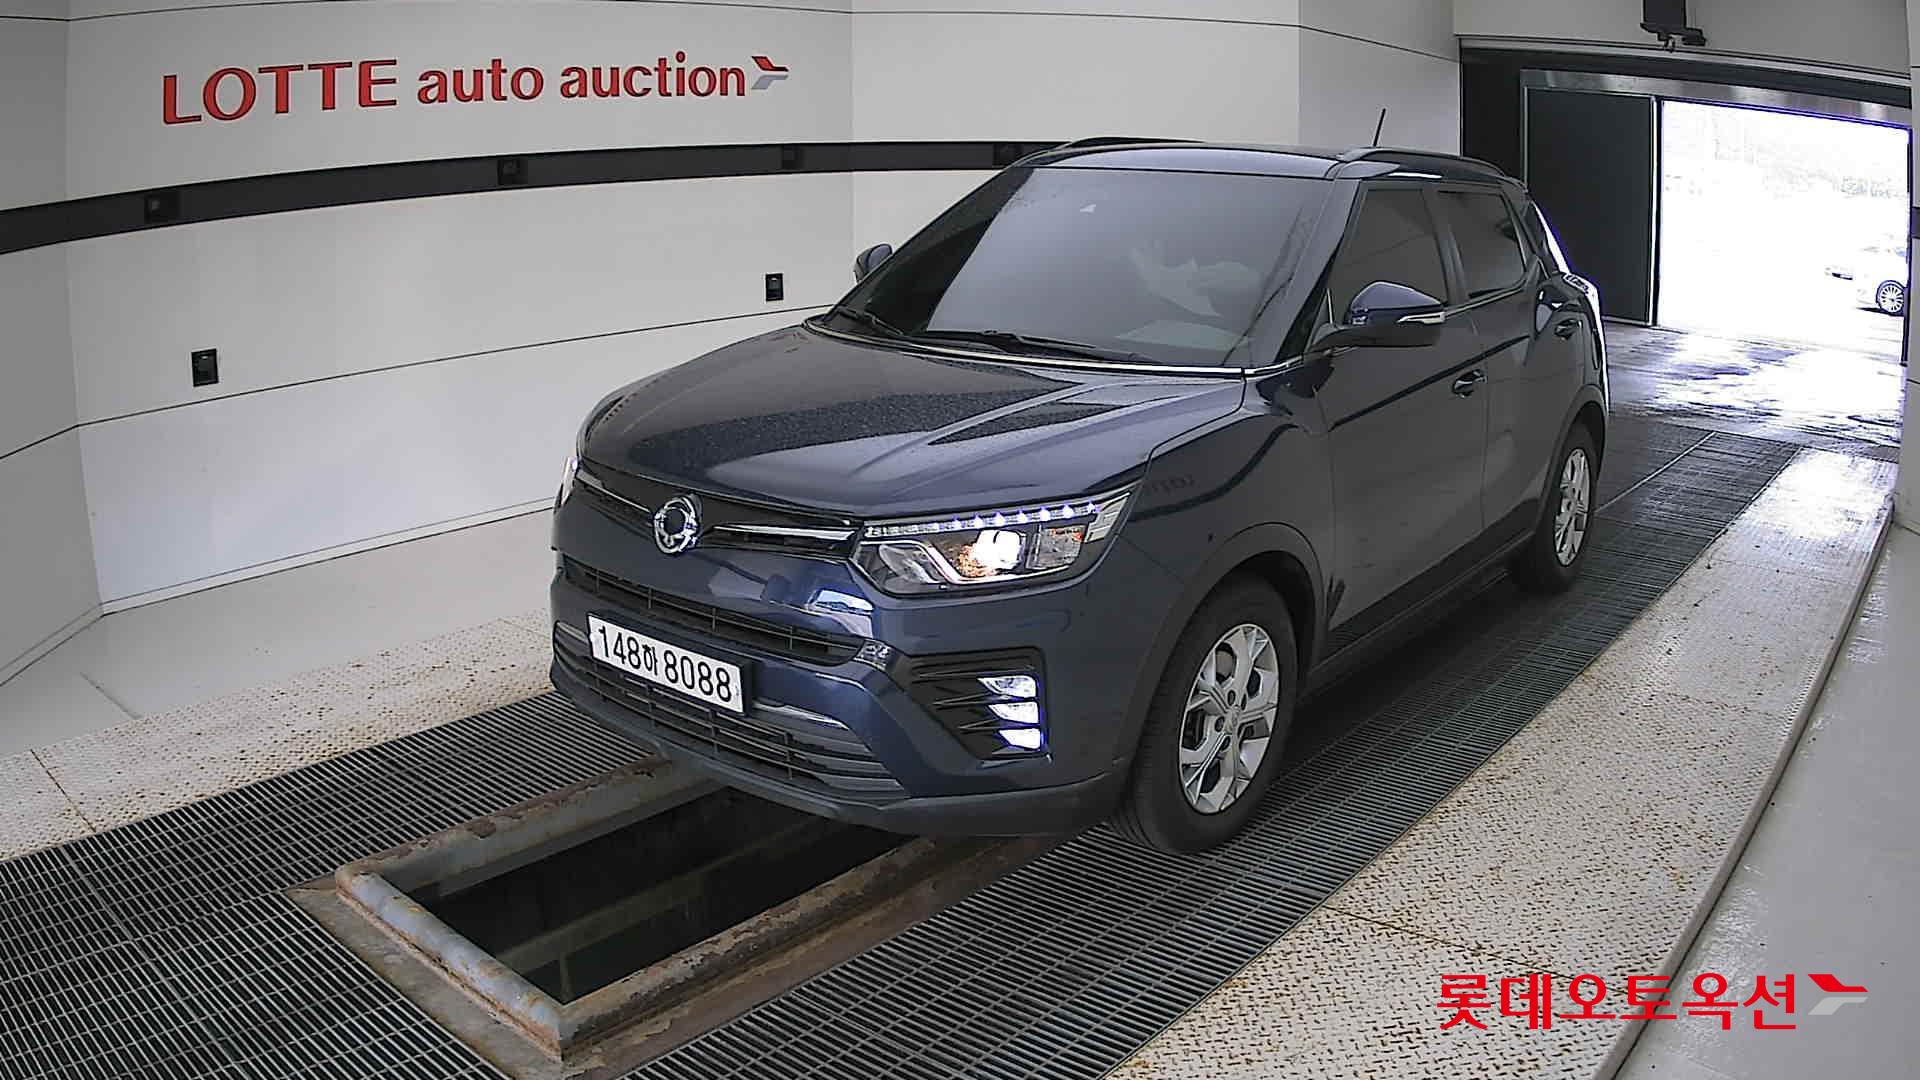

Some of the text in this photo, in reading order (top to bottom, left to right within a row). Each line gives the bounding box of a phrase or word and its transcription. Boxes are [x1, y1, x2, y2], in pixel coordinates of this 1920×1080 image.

[163, 51, 747, 124] LOTTE auto auction
